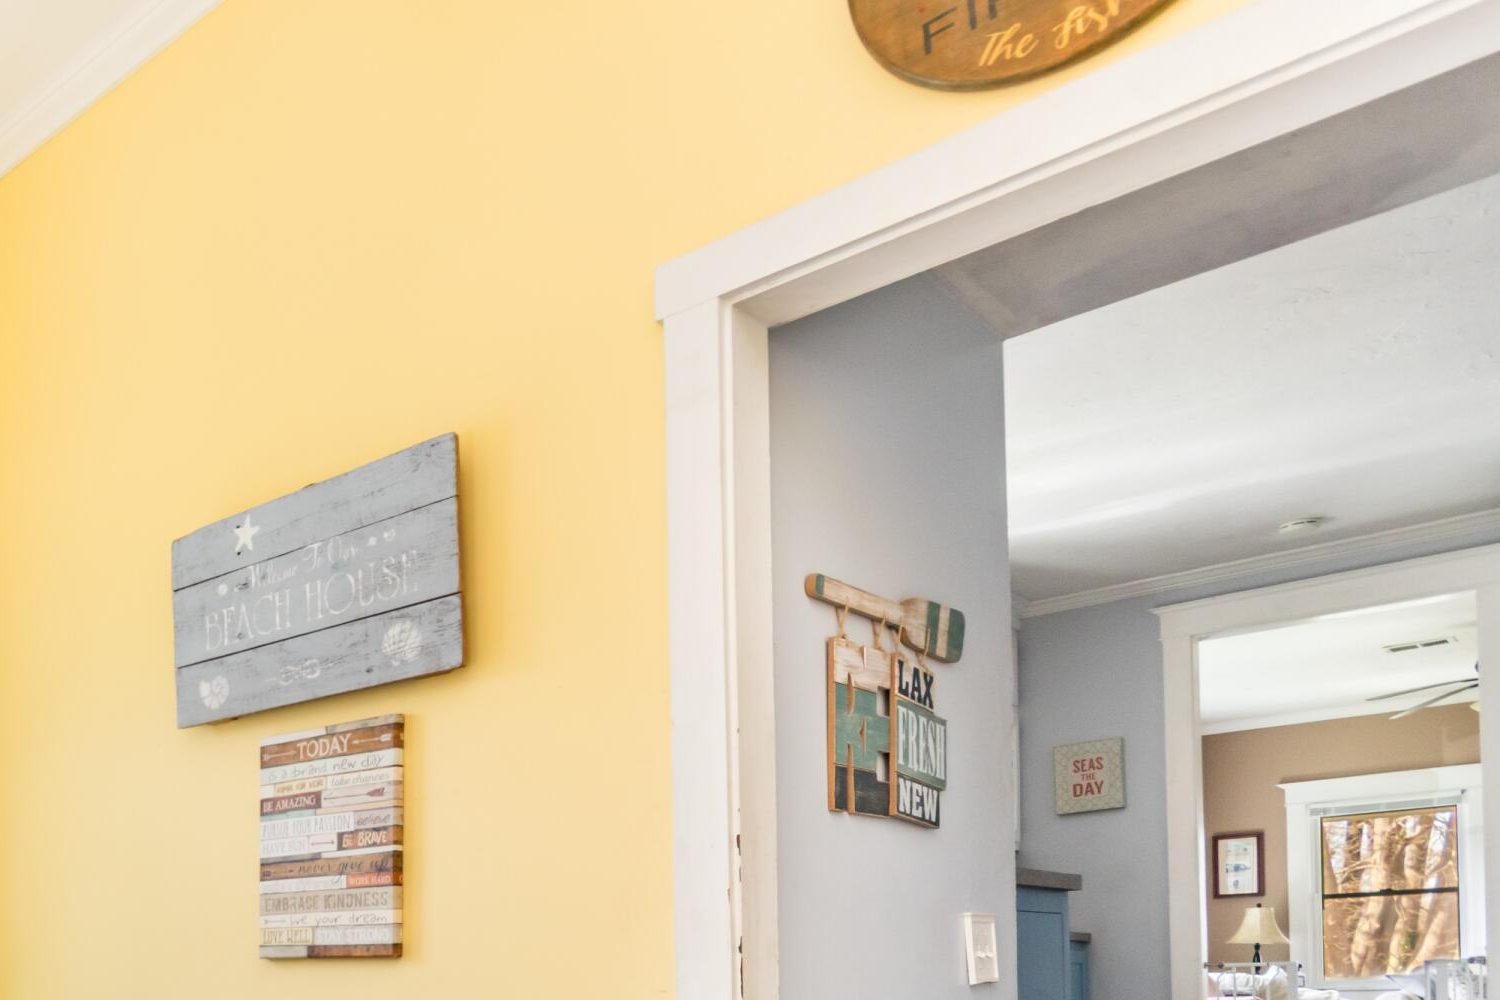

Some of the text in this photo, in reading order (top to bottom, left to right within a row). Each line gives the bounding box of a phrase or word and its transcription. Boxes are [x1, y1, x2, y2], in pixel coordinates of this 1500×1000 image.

[979, 22, 1039, 67] The
[302, 541, 325, 571] To
[327, 535, 359, 564] Our
[204, 549, 419, 651] BEACH HOUSE
[898, 659, 934, 709] LAX
[296, 733, 352, 760] TODAY
[897, 704, 947, 781] FRESH
[332, 757, 357, 771] new
[360, 753, 385, 772] day
[1072, 756, 1104, 773] SEAS
[1081, 771, 1097, 781] THE
[1072, 780, 1104, 797] DAY
[275, 794, 317, 812] AMAZING
[898, 778, 938, 823] NEW
[313, 814, 352, 833] PASSION
[357, 830, 388, 847] BRAVE
[264, 891, 389, 913] EMBRACE KINDNESS
[314, 914, 343, 928] your
[348, 910, 388, 924] dream
[262, 928, 311, 945] LOVE WELL
